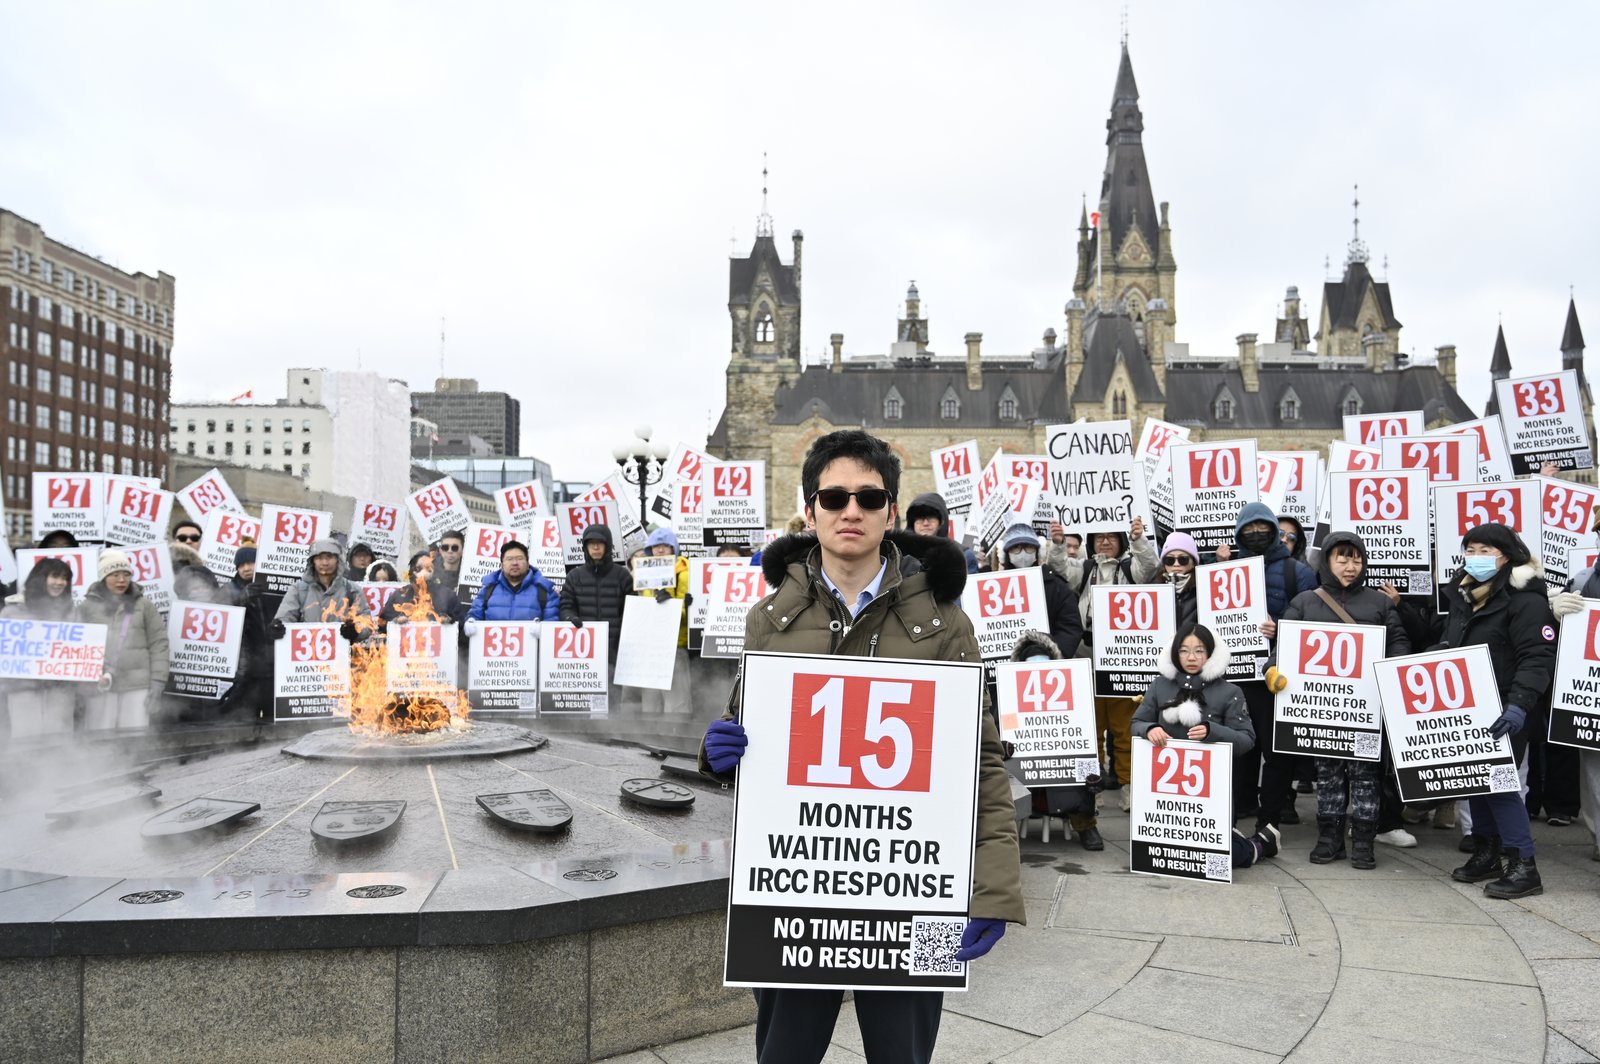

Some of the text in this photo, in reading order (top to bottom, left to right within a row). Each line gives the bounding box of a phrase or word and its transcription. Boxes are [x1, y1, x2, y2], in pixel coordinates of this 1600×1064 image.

[1518, 379, 1560, 416] 33
[1524, 418, 1562, 429] MONTHS
[1516, 426, 1574, 440] WAITING FOR
[1050, 432, 1132, 459] CANADA
[1513, 435, 1581, 449] IRCC RESPONSE
[944, 449, 966, 479] 27
[1408, 443, 1452, 481] 21
[1524, 454, 1536, 462] NO
[1529, 461, 1540, 469] NO
[1195, 449, 1236, 488] 70
[718, 467, 749, 496] 42
[948, 478, 970, 488] MONTHS
[1052, 470, 1131, 496] WHAT ARE
[52, 479, 86, 507] 27
[193, 480, 222, 511] 68
[419, 486, 451, 515] 39
[509, 486, 535, 512] 19
[944, 488, 967, 498] WAITING
[1195, 490, 1236, 501] MONTHS
[1356, 479, 1402, 519] 68
[125, 488, 154, 520] 31
[1055, 494, 1134, 526] YOU DOING?
[1186, 501, 1247, 512] WAITING FOR
[1465, 489, 1515, 530] 53
[1544, 487, 1588, 531] 35
[365, 504, 395, 530] 25
[513, 511, 536, 521] MONTHS
[1180, 515, 1203, 523] IRCC
[122, 519, 150, 530] MONTHS
[279, 514, 313, 544] 39
[1356, 525, 1402, 534] MONTHS
[1195, 539, 1207, 547] NO
[1393, 537, 1415, 547] FOR
[267, 554, 299, 564] WAITING
[730, 572, 766, 602] 51
[1214, 568, 1246, 609] 30
[984, 577, 1024, 616] 34
[1114, 593, 1154, 629] 30
[1215, 613, 1248, 623] MONTHS
[186, 609, 223, 641] 39
[987, 618, 1026, 630] MONTHS
[1244, 624, 1258, 634] FOR
[42, 623, 84, 641] THE
[978, 630, 1017, 643] WAITING
[295, 629, 333, 661] 36
[406, 627, 435, 657] 11
[487, 627, 520, 657] 35
[557, 628, 591, 658] 20
[1114, 636, 1154, 644] MONTHS
[184, 644, 219, 653] MONTHS
[1105, 647, 1142, 655] WAITING
[1305, 631, 1357, 677] 20
[174, 652, 227, 664] WAITING FOR
[1100, 658, 1120, 667] IRCC
[187, 663, 231, 673] RESPONSE
[286, 675, 325, 683] WAITING
[563, 680, 603, 688] RESPONSE
[1109, 674, 1120, 682] NO
[187, 684, 217, 693] RESULTS
[300, 684, 345, 693] RESPONSE
[1023, 669, 1068, 711] 42
[1113, 683, 1125, 691] NO
[1303, 682, 1354, 695] MONTHS
[1405, 661, 1465, 713] 90
[1291, 694, 1367, 710] WAITING FOR
[1562, 693, 1592, 706] IRCC
[1024, 715, 1070, 726] MONTHS
[1283, 707, 1374, 724] IRCC RESPONSE
[1416, 715, 1472, 731] MONTHS
[1573, 716, 1589, 727] NO
[806, 677, 913, 788] 15
[1014, 727, 1082, 738] WAITING FOR
[1293, 727, 1307, 736] NO
[1405, 728, 1491, 747] WAITING FOR
[1576, 729, 1593, 740] NO
[1035, 740, 1090, 751] RESPONSE
[1297, 738, 1355, 752] NO RESULTS
[1401, 741, 1502, 762] IRCC RESPONSE
[1020, 760, 1034, 769] NO
[1157, 748, 1204, 796] 25
[1418, 763, 1492, 780] NO TIMELINES
[1025, 769, 1076, 779] NO RESULTS
[1425, 776, 1490, 791] NO RESULTS
[1157, 800, 1203, 813] MONTHS
[799, 801, 913, 831] MONTHS
[1145, 812, 1216, 829] WAITING FOR
[1138, 825, 1223, 844] IRCC RESPONSE
[768, 834, 941, 865] WAITING FOR
[1148, 846, 1161, 856] NO
[1152, 858, 1206, 873] NO RESULTS
[748, 867, 955, 899] IRCC RESPONSE
[214, 889, 312, 900] 1873
[773, 918, 805, 939] NO
[782, 946, 910, 970] NO RESULTS
